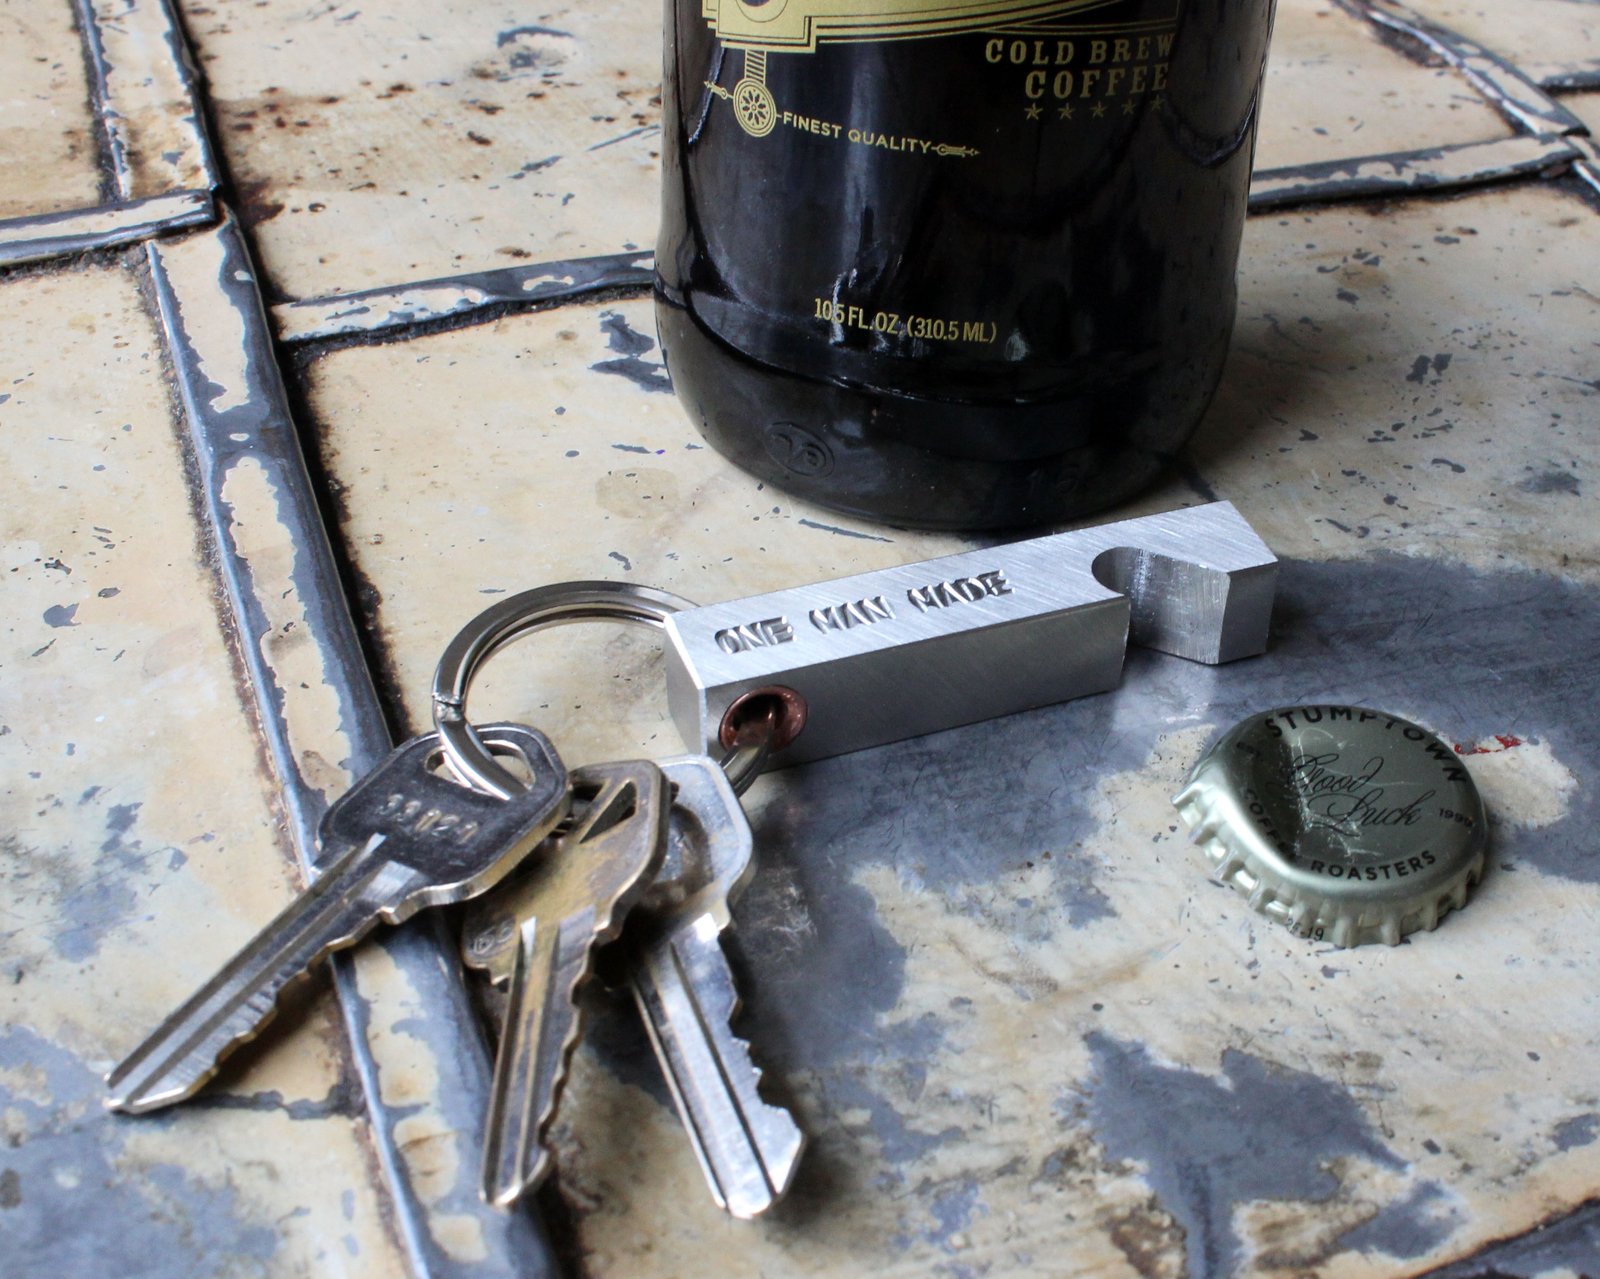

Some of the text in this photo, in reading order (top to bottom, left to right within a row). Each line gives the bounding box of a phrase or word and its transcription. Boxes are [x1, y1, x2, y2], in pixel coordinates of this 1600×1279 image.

[985, 32, 1176, 65] COLD BREW
[1025, 62, 1169, 99] COFFEE
[783, 111, 932, 154] FINEST QUALITY
[963, 321, 997, 344] ML)
[714, 569, 1016, 654] ONE MAN MADE
[1264, 706, 1467, 783] STUMPTOWN
[1285, 752, 1385, 796] Good
[1307, 788, 1437, 837] Luck
[1310, 850, 1436, 881] ROASTERS
